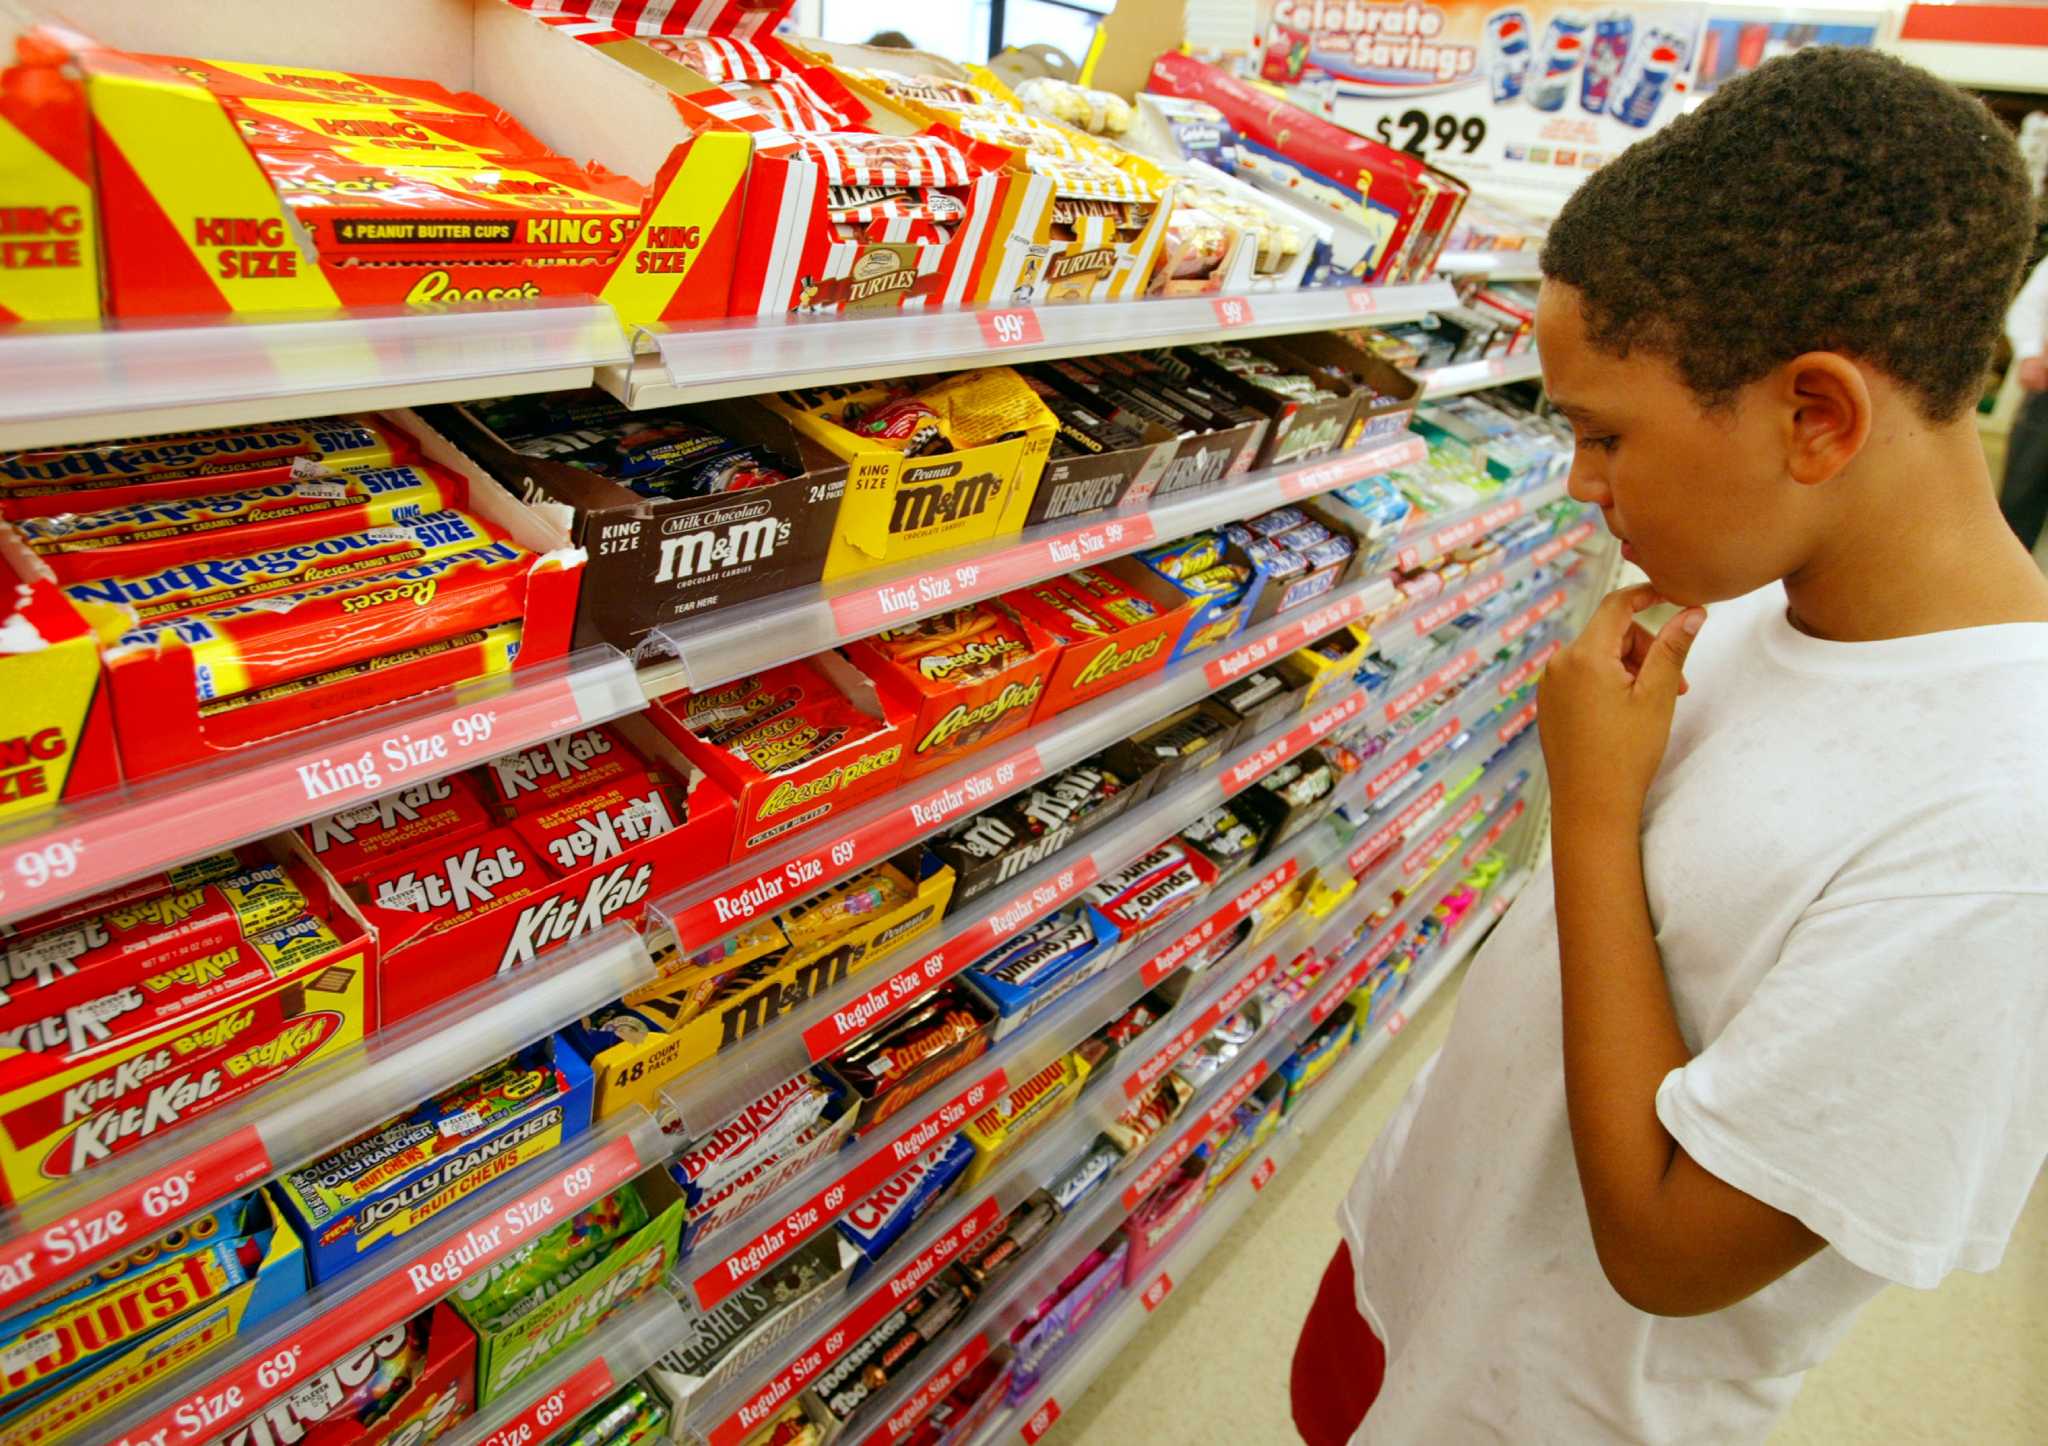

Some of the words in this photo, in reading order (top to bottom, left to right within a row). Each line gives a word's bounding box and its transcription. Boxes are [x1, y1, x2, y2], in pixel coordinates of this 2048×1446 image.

[1353, 34, 1476, 80] Savings
[314, 117, 429, 142] KING
[195, 217, 284, 248] KING
[342, 226, 354, 238] 4
[356, 225, 413, 239] PEANUT
[418, 225, 471, 239] BUTTER
[474, 225, 509, 239] CUPS
[526, 219, 603, 245] KING
[646, 226, 701, 250] KING
[0, 241, 80, 269] IZE
[220, 251, 297, 279] SIZE
[635, 251, 686, 274] SIZE
[1051, 248, 1117, 279] TURTLES
[849, 268, 918, 303] TURTLES
[313, 428, 376, 453] SIZE
[360, 466, 422, 494] SIZE
[856, 478, 887, 490] SIZE
[859, 465, 890, 478] KING
[911, 465, 954, 481] Peanut
[807, 485, 827, 503] 24
[391, 504, 421, 522] KING
[669, 517, 701, 533] Milk
[703, 503, 765, 526] Chocolate
[414, 519, 476, 548] SIZE
[602, 521, 641, 539] KING
[600, 537, 640, 555] SIZE
[1049, 539, 1080, 564] King
[1079, 530, 1105, 553] Size
[190, 590, 238, 606] PEANUTS
[249, 577, 293, 594] CARAMEL
[676, 573, 720, 589] CHOCOLATE
[877, 586, 920, 615] King
[919, 576, 951, 603] Size
[674, 600, 696, 614] TEAR
[296, 751, 382, 802] King
[382, 733, 448, 773] Size
[909, 790, 965, 828] Regular
[963, 777, 994, 802] Size
[380, 813, 461, 849] CHOCOLATE
[402, 808, 457, 834] WAFERS
[475, 887, 533, 918] WAFERS
[713, 880, 784, 925] Regular
[784, 855, 823, 889] Size
[989, 900, 1036, 937] Regular
[1034, 884, 1059, 910] Size
[833, 994, 889, 1036] Regular
[888, 971, 920, 1002] Size
[646, 1050, 679, 1075] PACKS
[647, 1039, 681, 1064] COUNT
[62, 1048, 174, 1126] KitKat
[614, 1062, 645, 1088] 48
[69, 1068, 223, 1176] KitKat
[892, 1122, 942, 1162] Regular
[938, 1099, 966, 1130] Size
[355, 1169, 444, 1236] JOLLY
[443, 1105, 563, 1189] RANCHER
[408, 1187, 459, 1227] FRUIT
[458, 1149, 519, 1196] CHEWS
[43, 1209, 129, 1266] Size
[407, 1224, 503, 1296] Regular
[503, 1192, 554, 1237] Size
[726, 1230, 788, 1281] Regular
[786, 1206, 820, 1239] Size
[889, 1256, 936, 1299] Regular
[933, 1234, 960, 1264] Size
[737, 1375, 795, 1429] Regular
[792, 1351, 823, 1383] Size
[174, 1384, 245, 1439] Size
